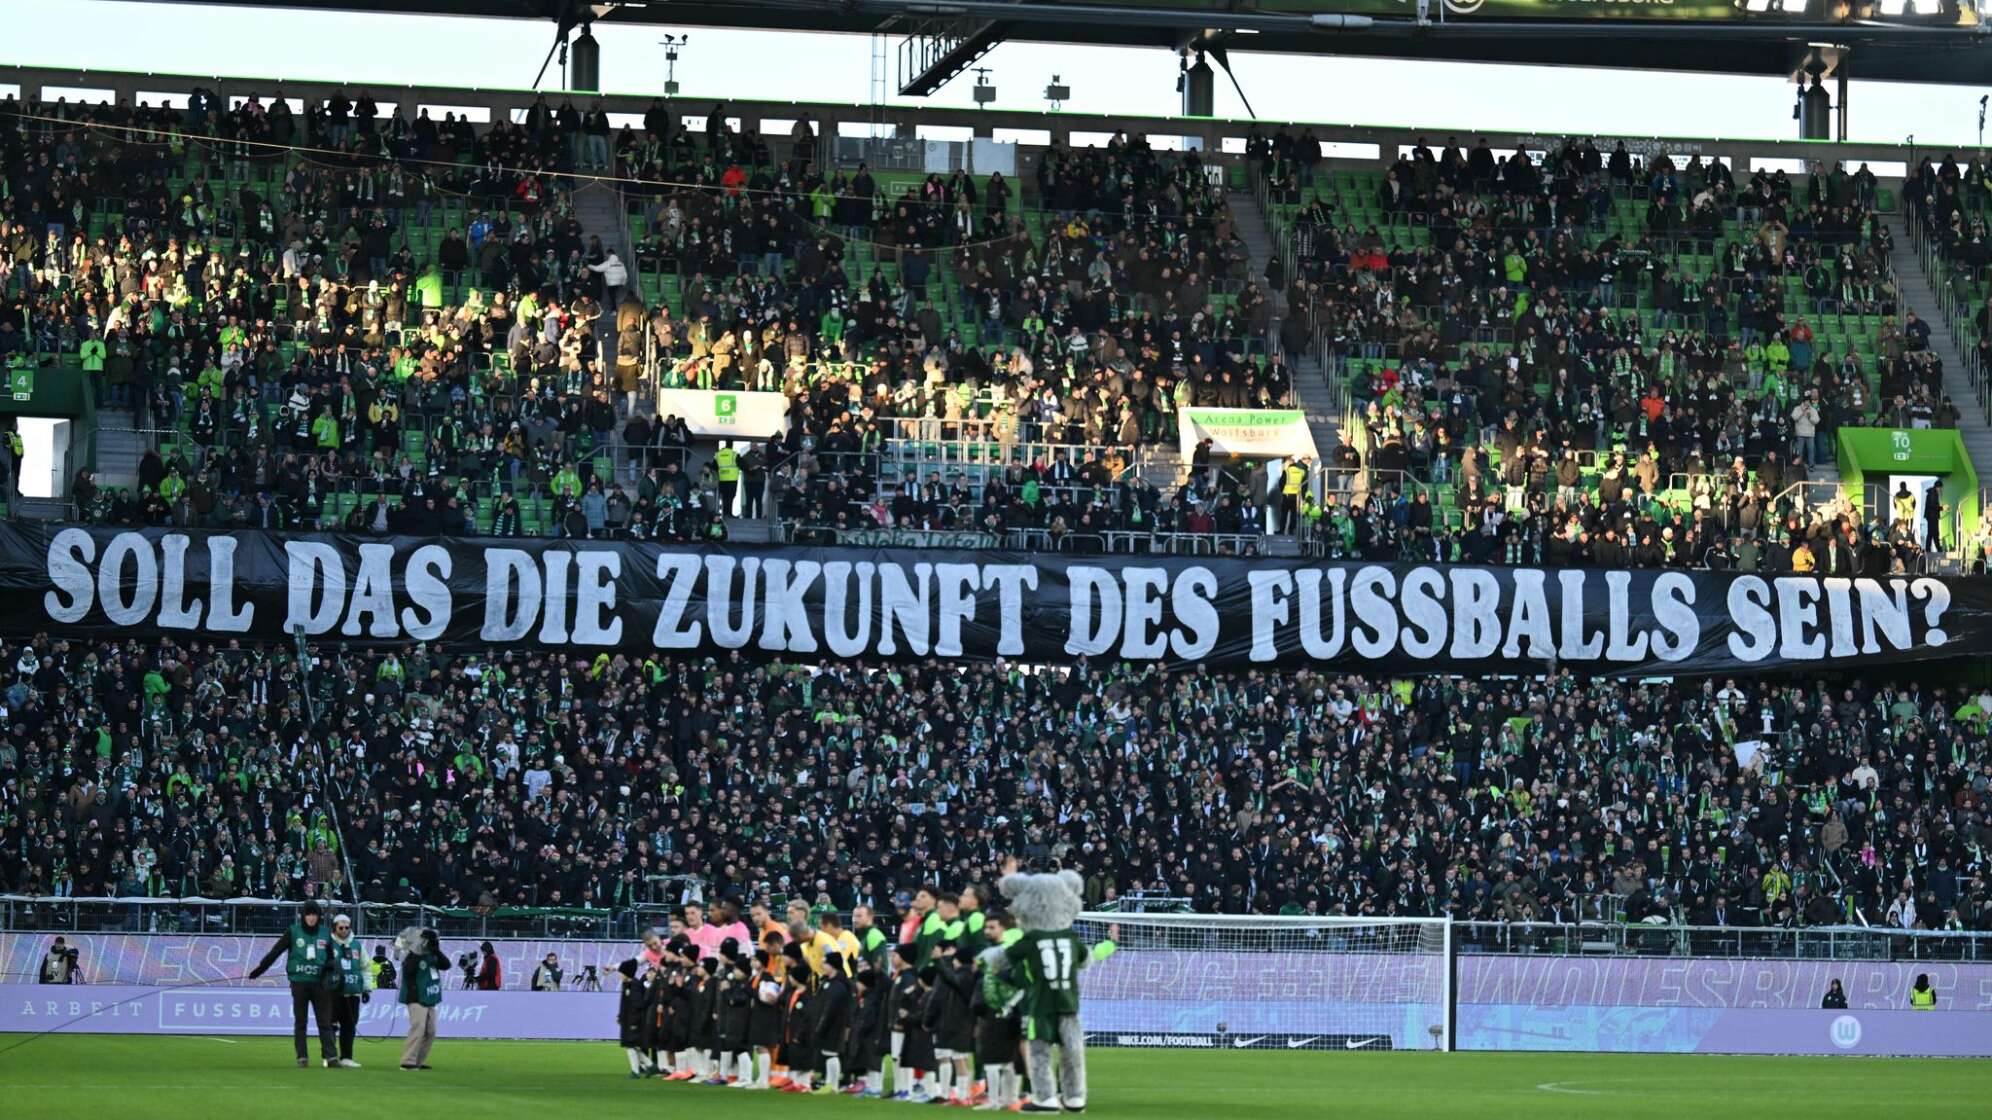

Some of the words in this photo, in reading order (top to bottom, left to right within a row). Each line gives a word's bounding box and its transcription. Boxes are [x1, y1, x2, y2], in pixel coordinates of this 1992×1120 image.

[17, 375, 27, 388] 4
[721, 399, 731, 412] 6
[1204, 414, 1242, 425] Arena
[1249, 413, 1287, 426] Power
[1893, 435, 1910, 449] 10
[45, 528, 254, 632] SOLL
[284, 541, 452, 640] DAS
[481, 548, 622, 645] DIE
[653, 553, 1038, 657] ZUKUNFT
[1064, 566, 1219, 660] DES
[1248, 565, 1700, 661] FUSSBALLS
[1727, 575, 1950, 662] SEIN?
[296, 964, 320, 975] HOS
[21, 1000, 143, 1017] ARBEIT
[1117, 1034, 1214, 1047] NIKE.COM/FOOTBALL
